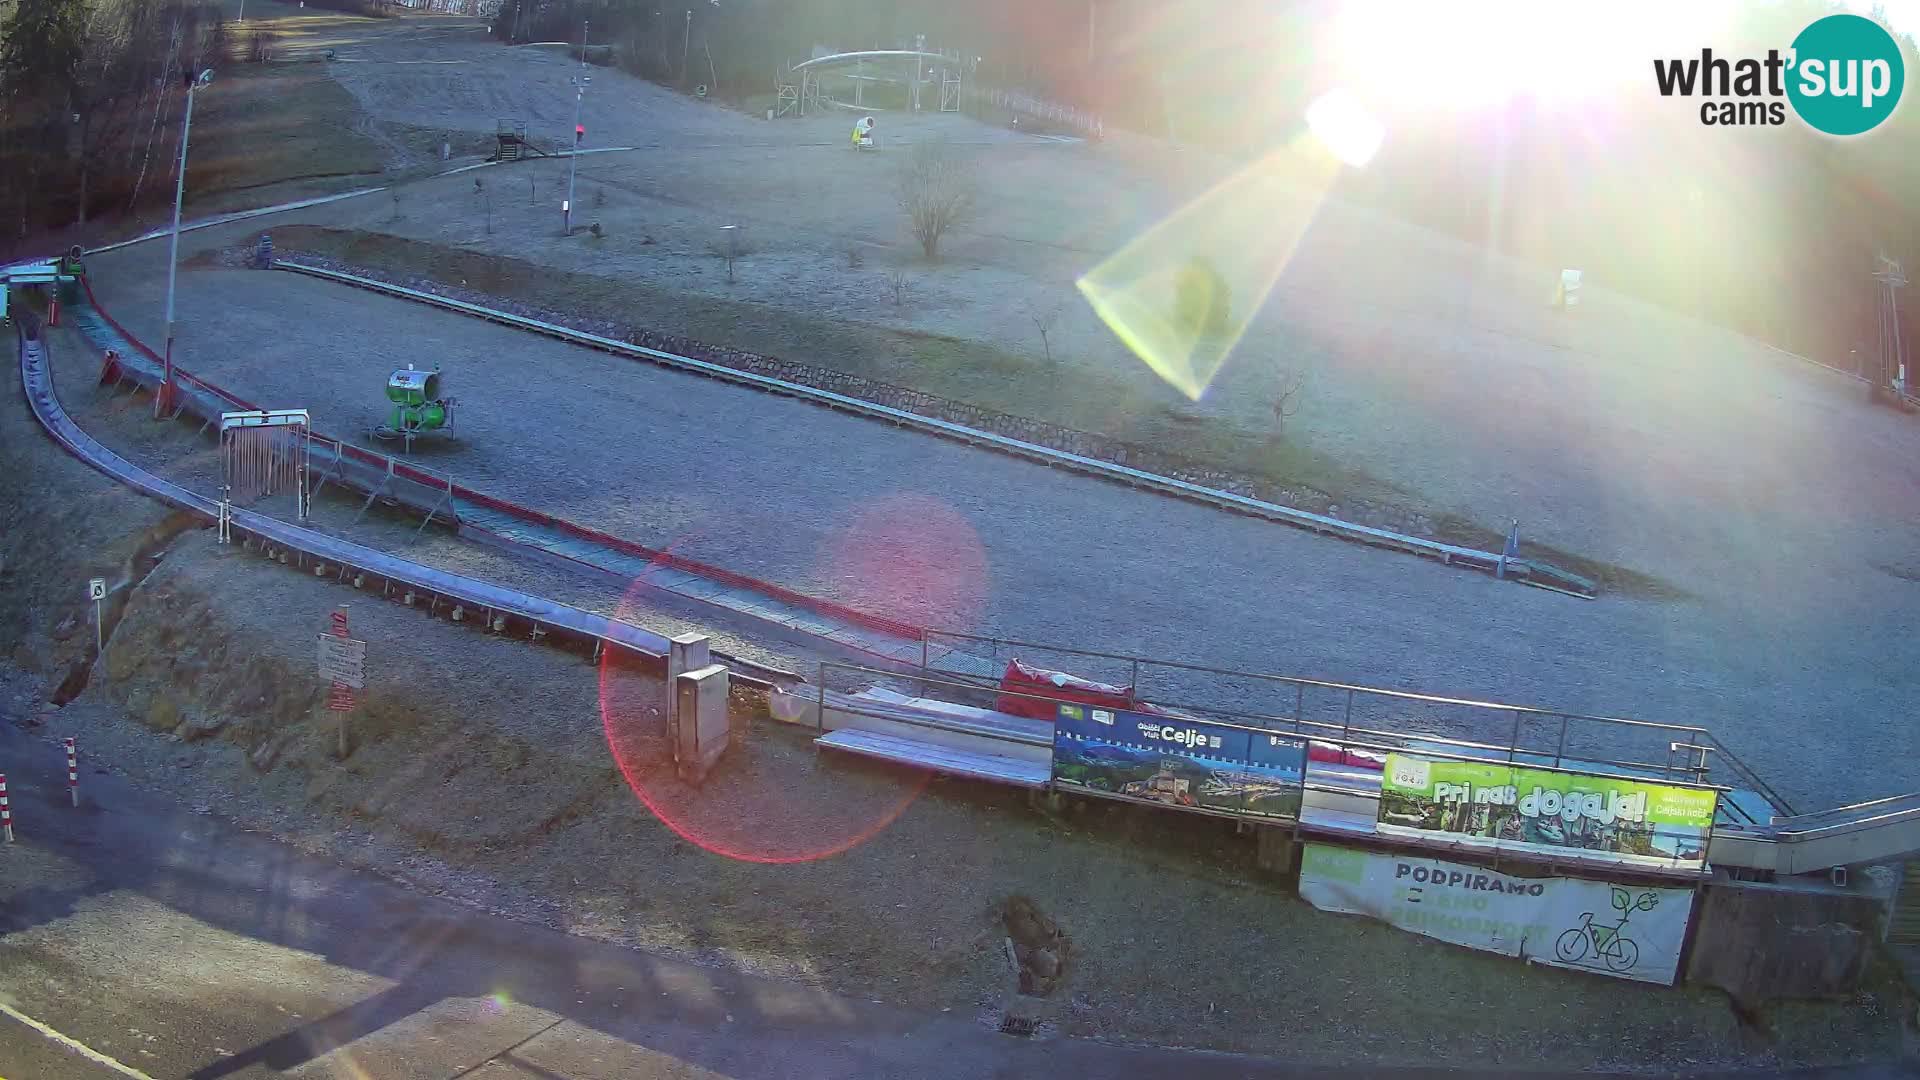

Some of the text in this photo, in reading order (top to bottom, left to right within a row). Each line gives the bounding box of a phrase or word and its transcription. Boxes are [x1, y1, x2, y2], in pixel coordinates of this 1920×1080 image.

[1161, 726, 1207, 748] Celje
[1433, 781, 1470, 803] Pri
[1474, 785, 1517, 805] nas
[1395, 863, 1545, 897] PODPIRAMO
